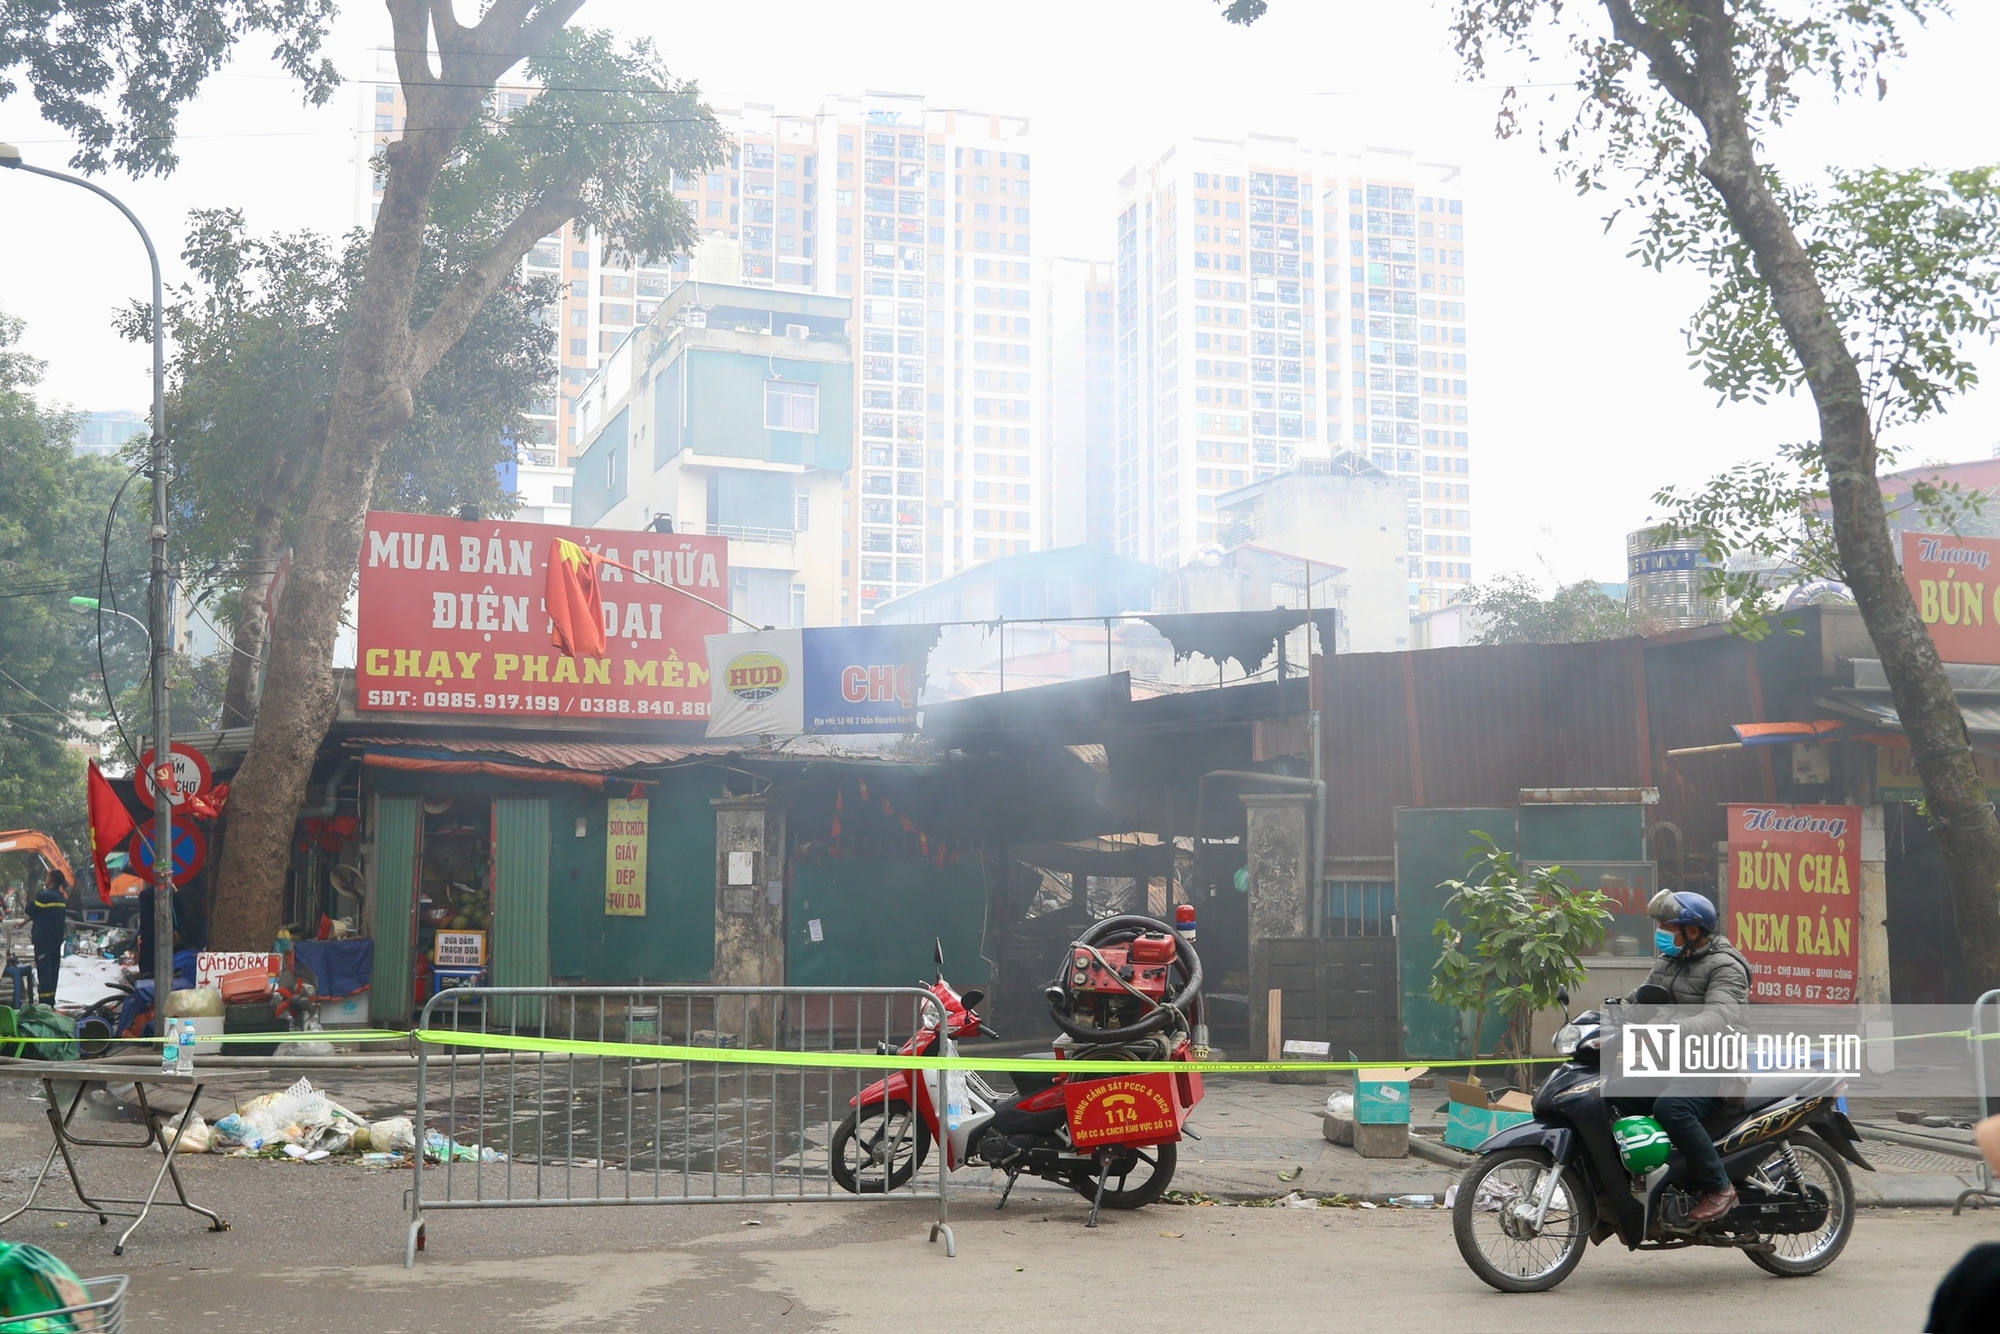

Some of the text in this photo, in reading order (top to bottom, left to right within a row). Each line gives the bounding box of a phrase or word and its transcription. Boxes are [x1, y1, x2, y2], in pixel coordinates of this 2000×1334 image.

[368, 530, 450, 571] MUA
[460, 528, 533, 576] BÁN
[632, 542, 720, 588] CHỮA
[1918, 538, 1991, 571] Hương
[1919, 567, 1985, 627] BÚN
[432, 585, 663, 649] ĐIỆN OẠI
[366, 648, 482, 687] CHẠY
[729, 665, 783, 687] HUD
[368, 690, 418, 707] SĐT:
[423, 691, 560, 711] 0985.917.199
[1743, 808, 1848, 838] Hương
[616, 866, 636, 885] DÉP
[1738, 838, 1851, 895] BÚN CHẢ
[609, 890, 641, 909] TÚI DA
[1736, 905, 1851, 957] NEM RÁN
[1763, 965, 1772, 974] 23
[1777, 965, 1792, 978] CHỢ
[1792, 967, 1811, 977] XANH
[1816, 968, 1832, 980] ĐỊNH
[1834, 967, 1853, 980] CÔNG
[1757, 982, 1782, 996] 093
[1785, 983, 1802, 998] 64
[1805, 984, 1822, 999] 67
[1826, 985, 1851, 1000] 323
[1074, 1081, 1170, 1125] PHÒNG CẢNH SÁT PCCC & CNCH
[1105, 1107, 1138, 1124] 114
[1076, 1129, 1088, 1141] ĐỘI
[1089, 1129, 1098, 1138] CC
[1106, 1126, 1125, 1136] CNCH
[1125, 1124, 1139, 1133] KHU
[1139, 1122, 1153, 1133] VỰC
[1154, 1118, 1164, 1129] SỐ
[1164, 1119, 1173, 1129] 13
